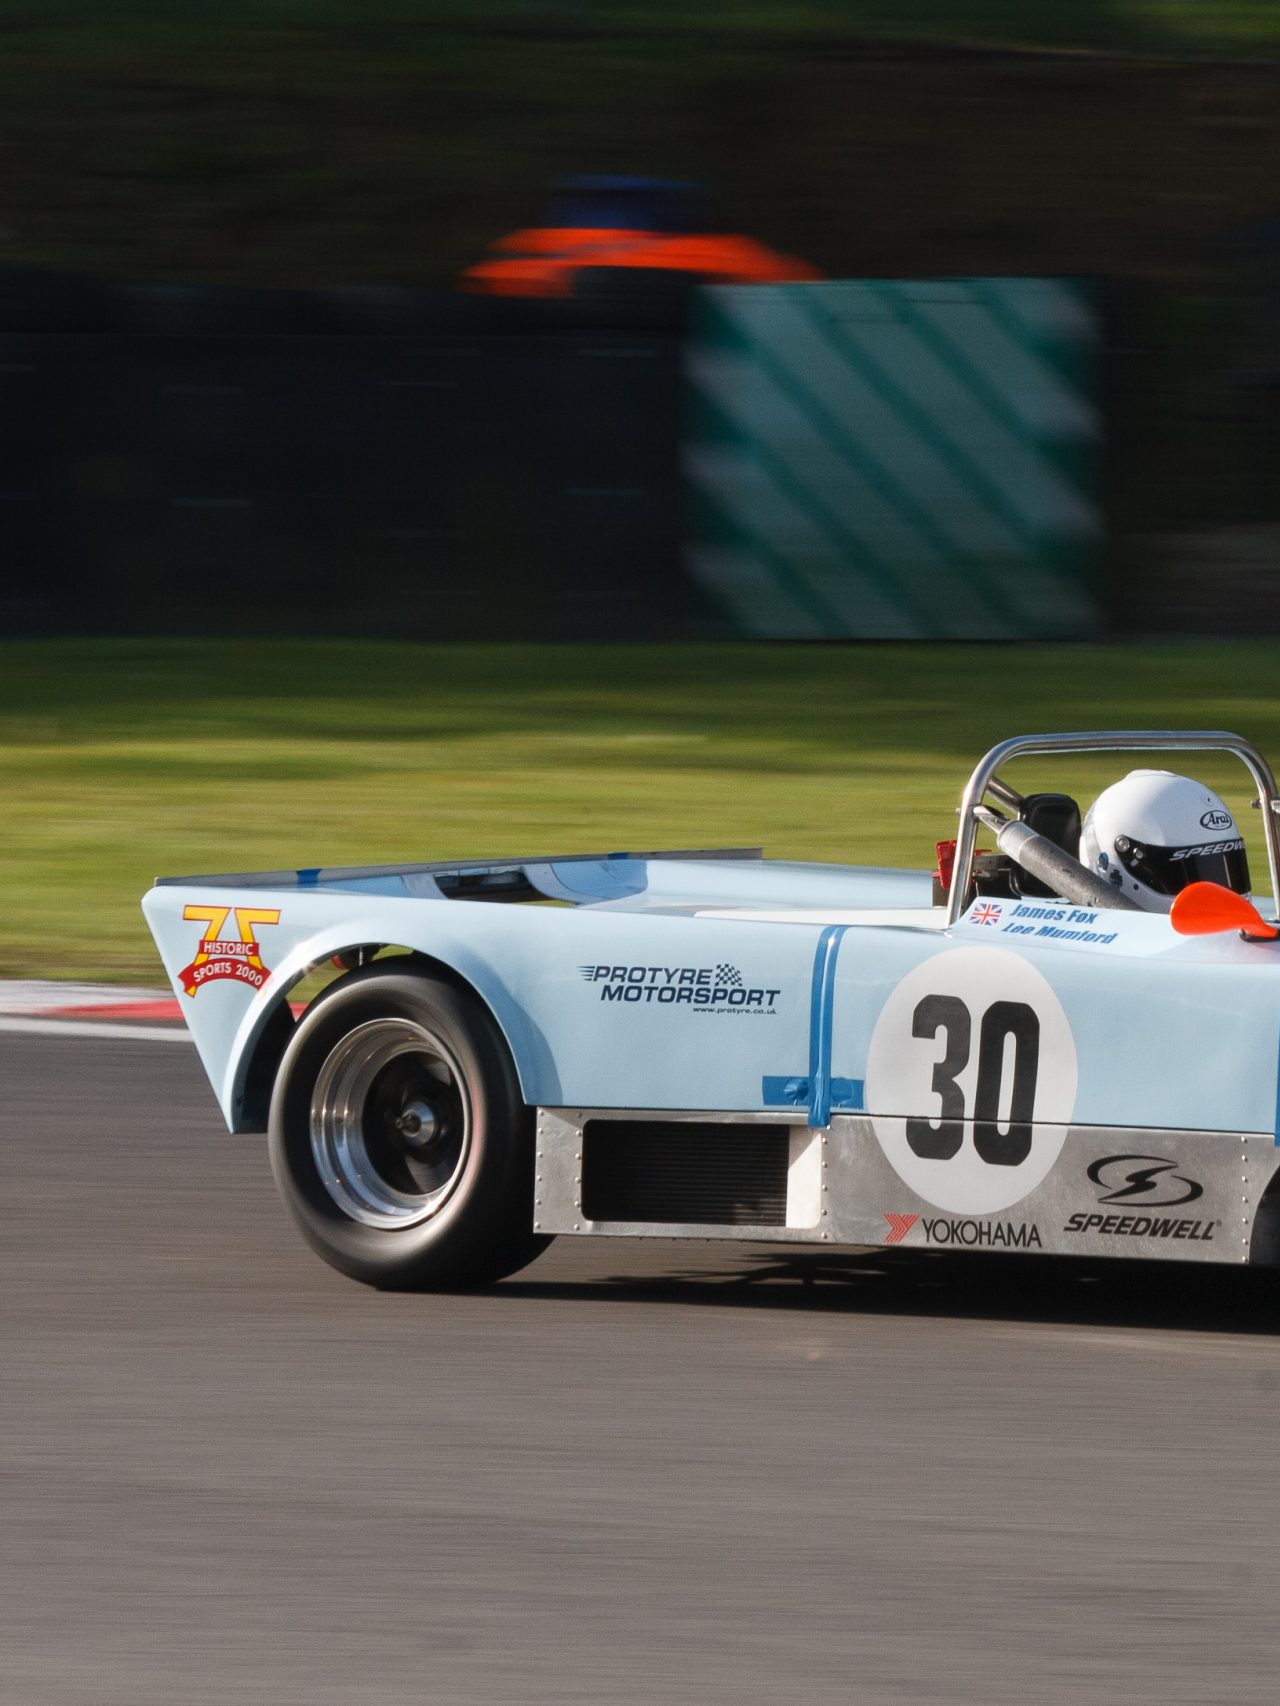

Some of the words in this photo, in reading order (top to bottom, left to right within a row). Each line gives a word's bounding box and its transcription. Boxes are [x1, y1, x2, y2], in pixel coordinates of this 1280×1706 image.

[1206, 812, 1230, 826] Arai
[1009, 904, 1067, 921] James
[1067, 909, 1099, 924] Fox
[1002, 922, 1035, 934] Lee
[1034, 926, 1118, 944] Mumford
[203, 942, 254, 955] HISTORIC
[193, 962, 232, 982] SPORTS
[235, 964, 263, 986] 2000
[593, 966, 714, 985] PROTYRE
[601, 985, 781, 1006] MOTORSPORT
[693, 1007, 777, 1015] www.protyre.co.uk
[906, 993, 1040, 1166] 30
[922, 1218, 1042, 1247] YOKOHAMA
[1063, 1213, 1216, 1241] SPEEDWELL
